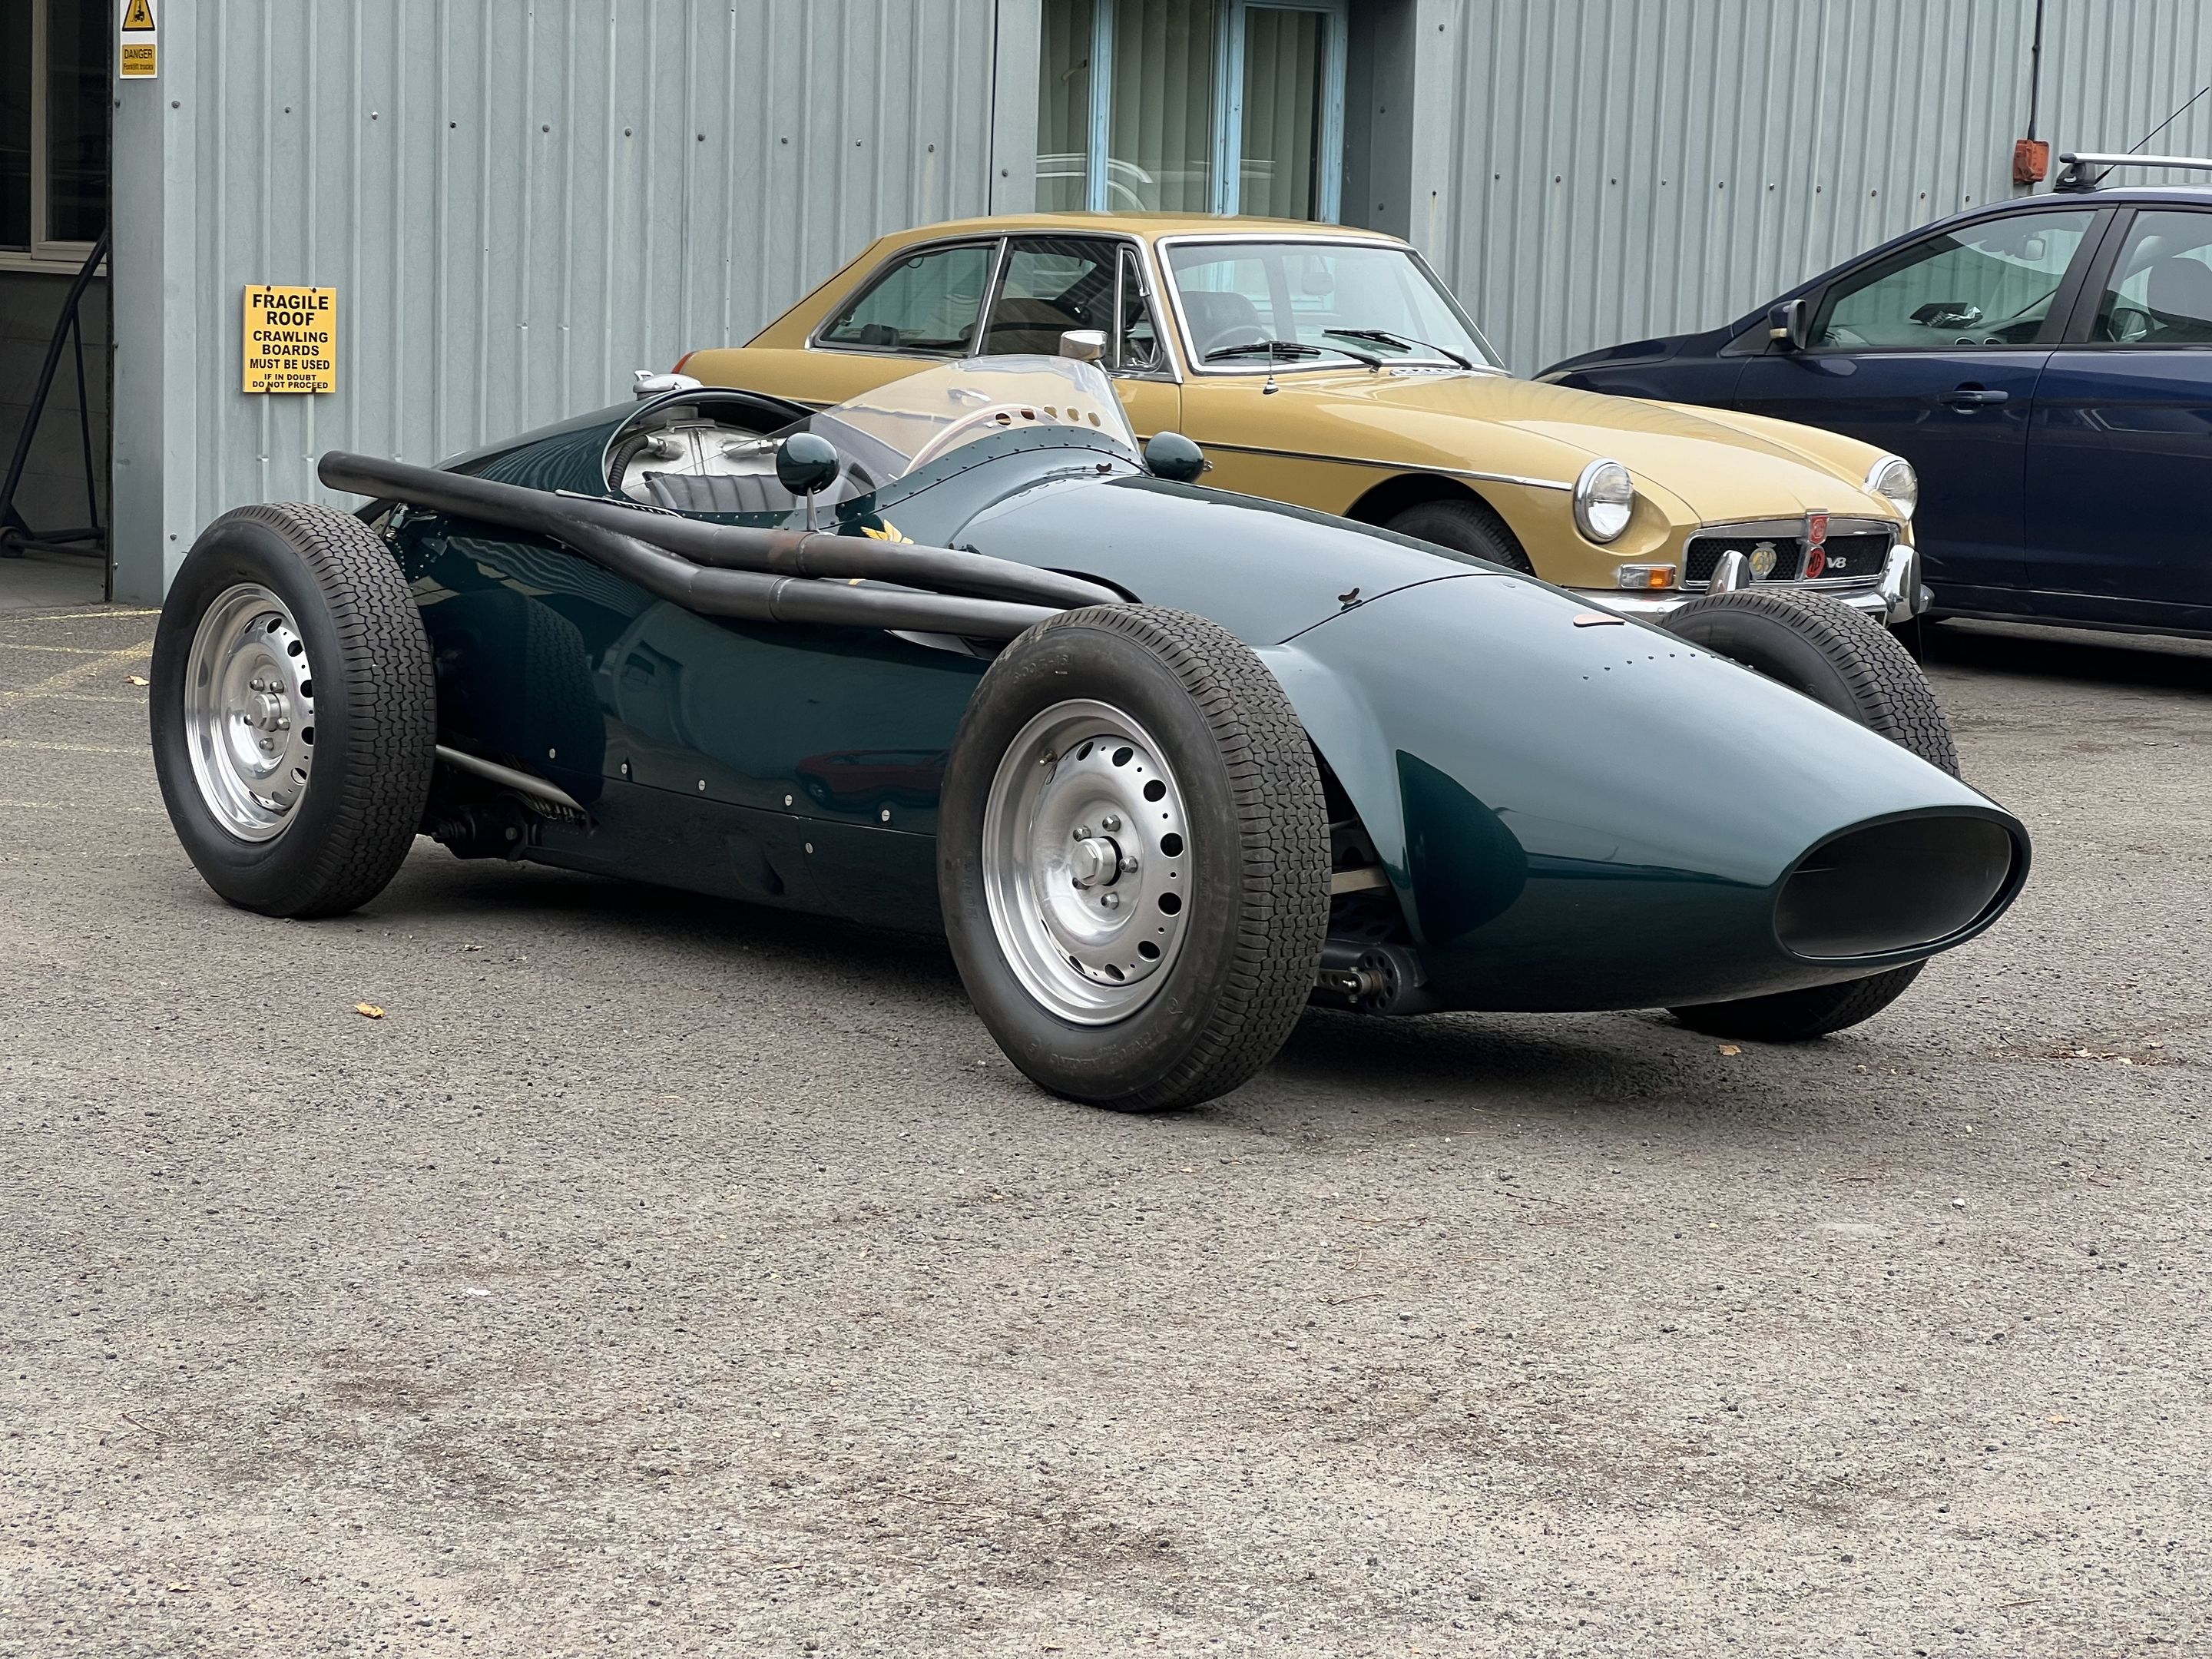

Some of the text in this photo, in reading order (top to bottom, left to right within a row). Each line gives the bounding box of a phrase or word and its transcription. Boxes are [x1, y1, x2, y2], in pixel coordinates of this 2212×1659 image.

[124, 49, 153, 58] DANGER
[253, 293, 329, 310] FRAGILE
[267, 311, 315, 326] ROOF
[253, 330, 329, 343] CRAWLING
[262, 344, 320, 356] BOARDS
[250, 359, 329, 369] MUST BE USED
[1826, 557, 1846, 568] V8
